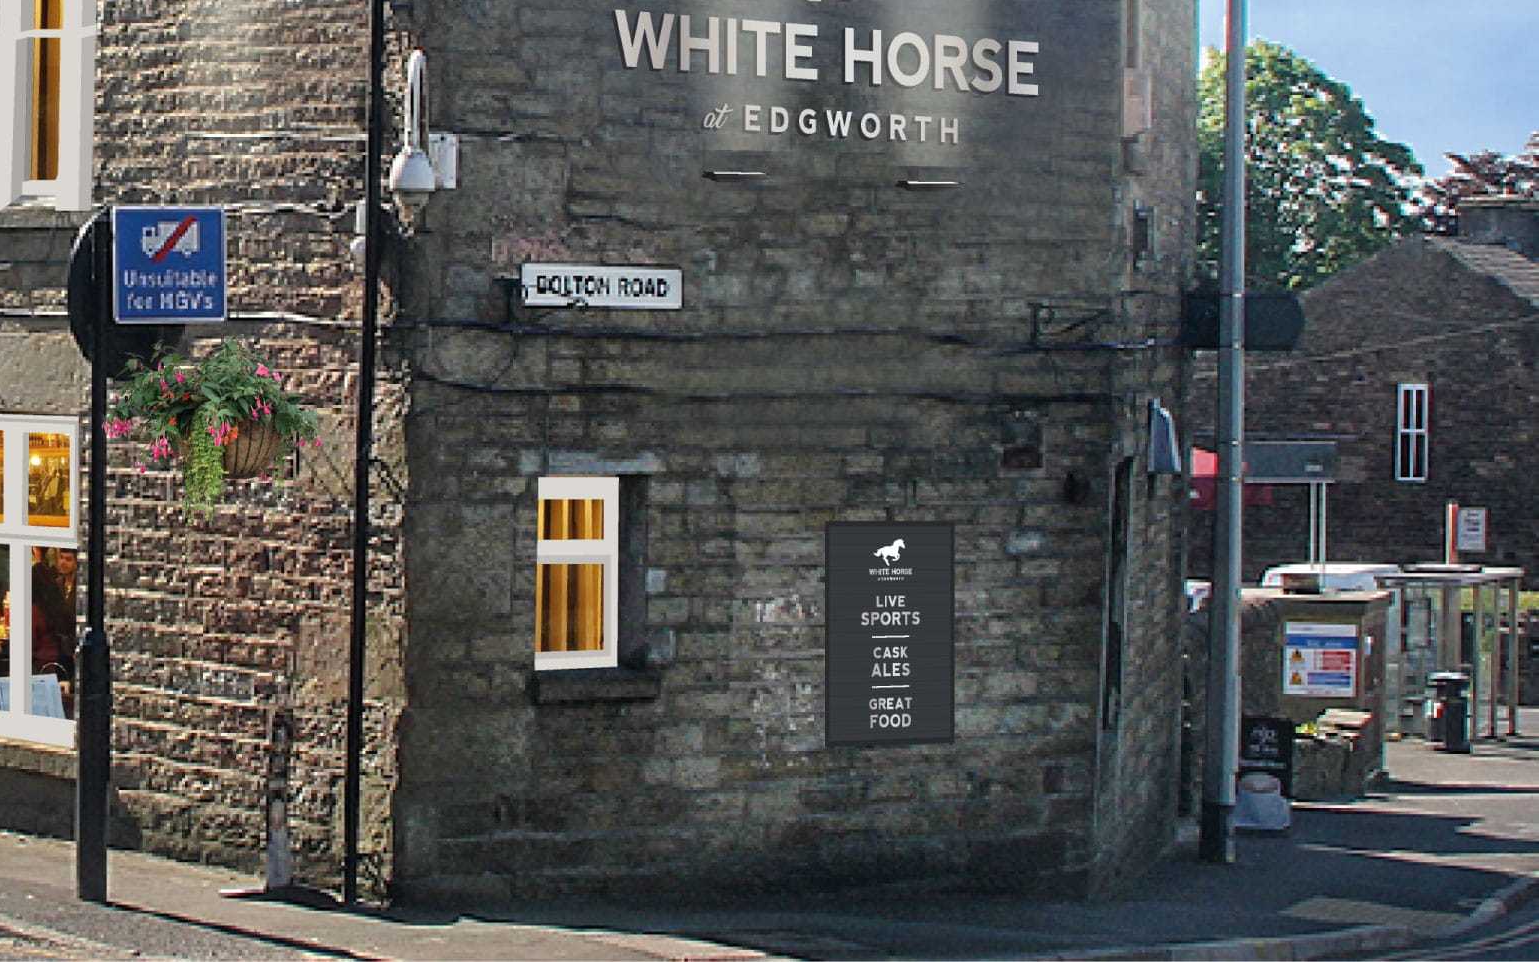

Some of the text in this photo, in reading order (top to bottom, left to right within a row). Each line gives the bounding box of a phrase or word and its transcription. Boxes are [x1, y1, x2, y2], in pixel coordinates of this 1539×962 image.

[614, 8, 1039, 96] WHITE HORSE
[703, 102, 959, 144] at EDGWORTH
[123, 269, 218, 289] Unsuitable
[536, 274, 670, 298] BOLTON ROAD
[127, 292, 153, 310] for
[868, 568, 913, 576] WHITE HORSE
[876, 595, 906, 608] LIVE
[861, 611, 921, 626] SPORTS
[873, 646, 908, 659] CASK
[871, 662, 911, 678] ALES
[868, 697, 913, 711] GREAT
[869, 713, 912, 729] FOOD
